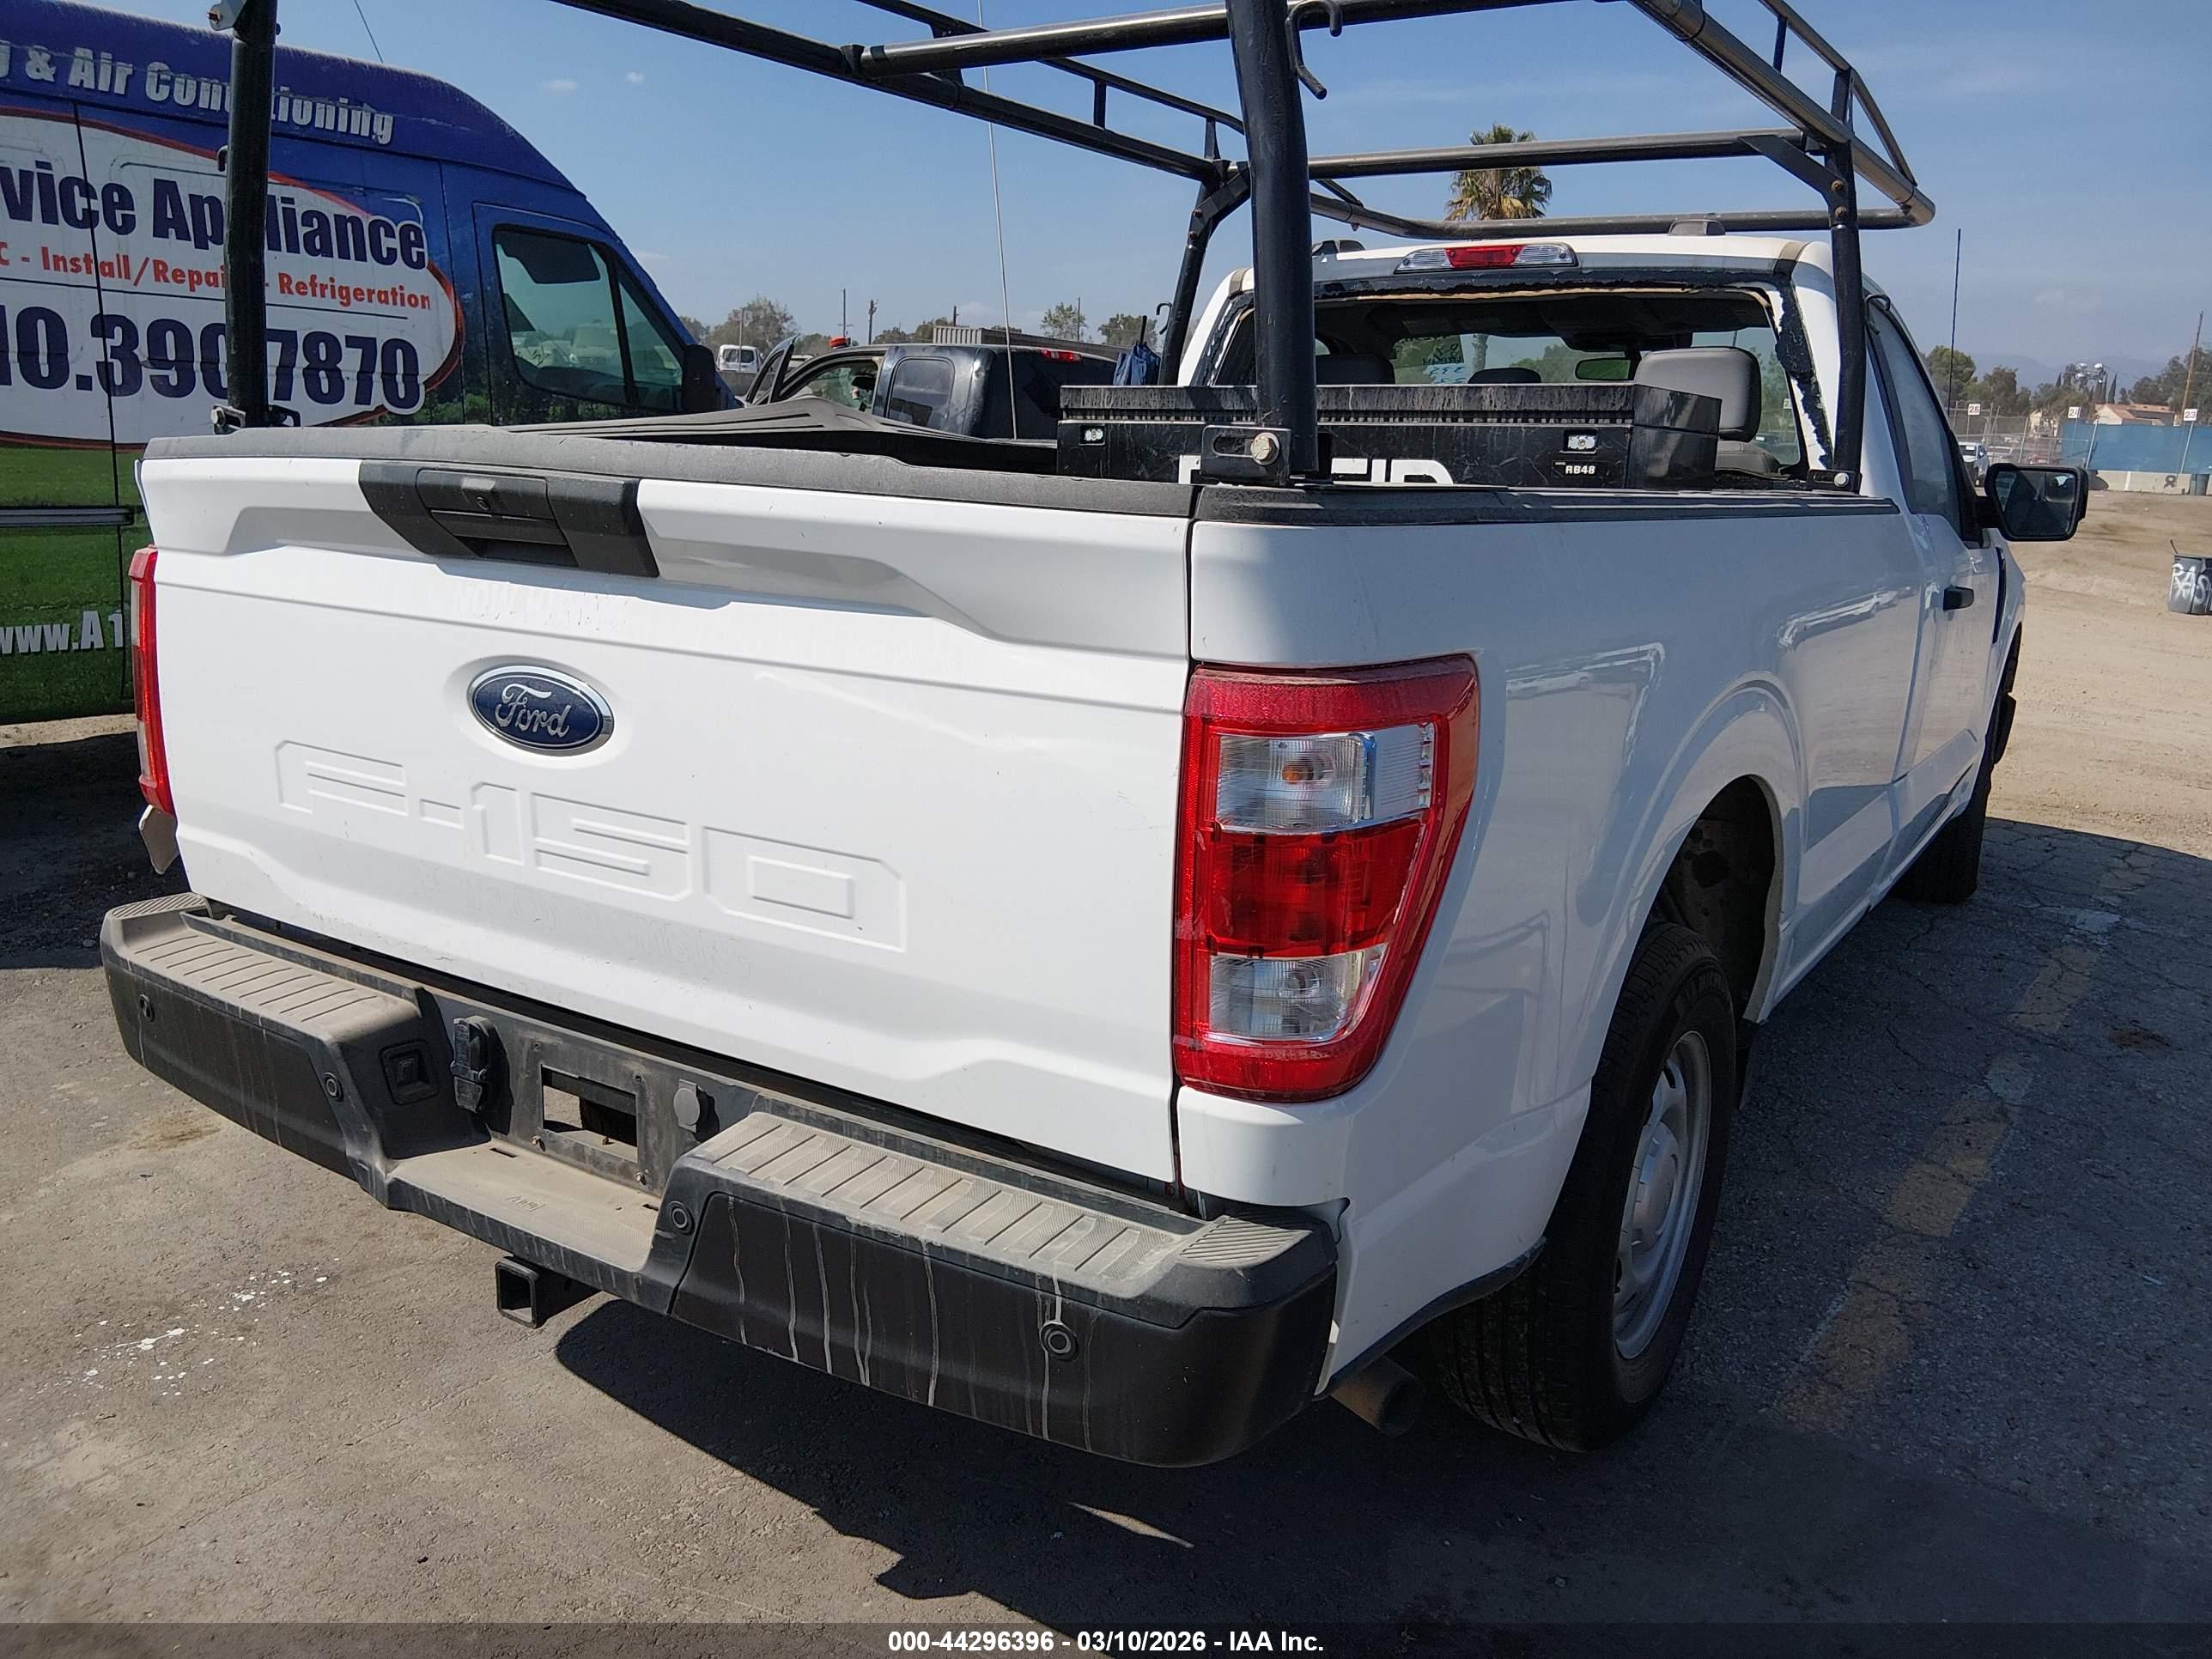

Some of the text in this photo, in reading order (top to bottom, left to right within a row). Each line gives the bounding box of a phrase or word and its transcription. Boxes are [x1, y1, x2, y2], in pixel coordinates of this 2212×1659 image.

[25, 46, 56, 82] &
[68, 46, 134, 95] Air
[145, 61, 394, 145] Conioning
[152, 177, 427, 270] Apliance
[40, 245, 226, 293] Install/Repai
[278, 272, 430, 309] Refrigeration
[2185, 410, 2197, 419] 23
[1565, 465, 1596, 475] RB48
[495, 683, 572, 738] Ford
[275, 739, 907, 953] F-150
